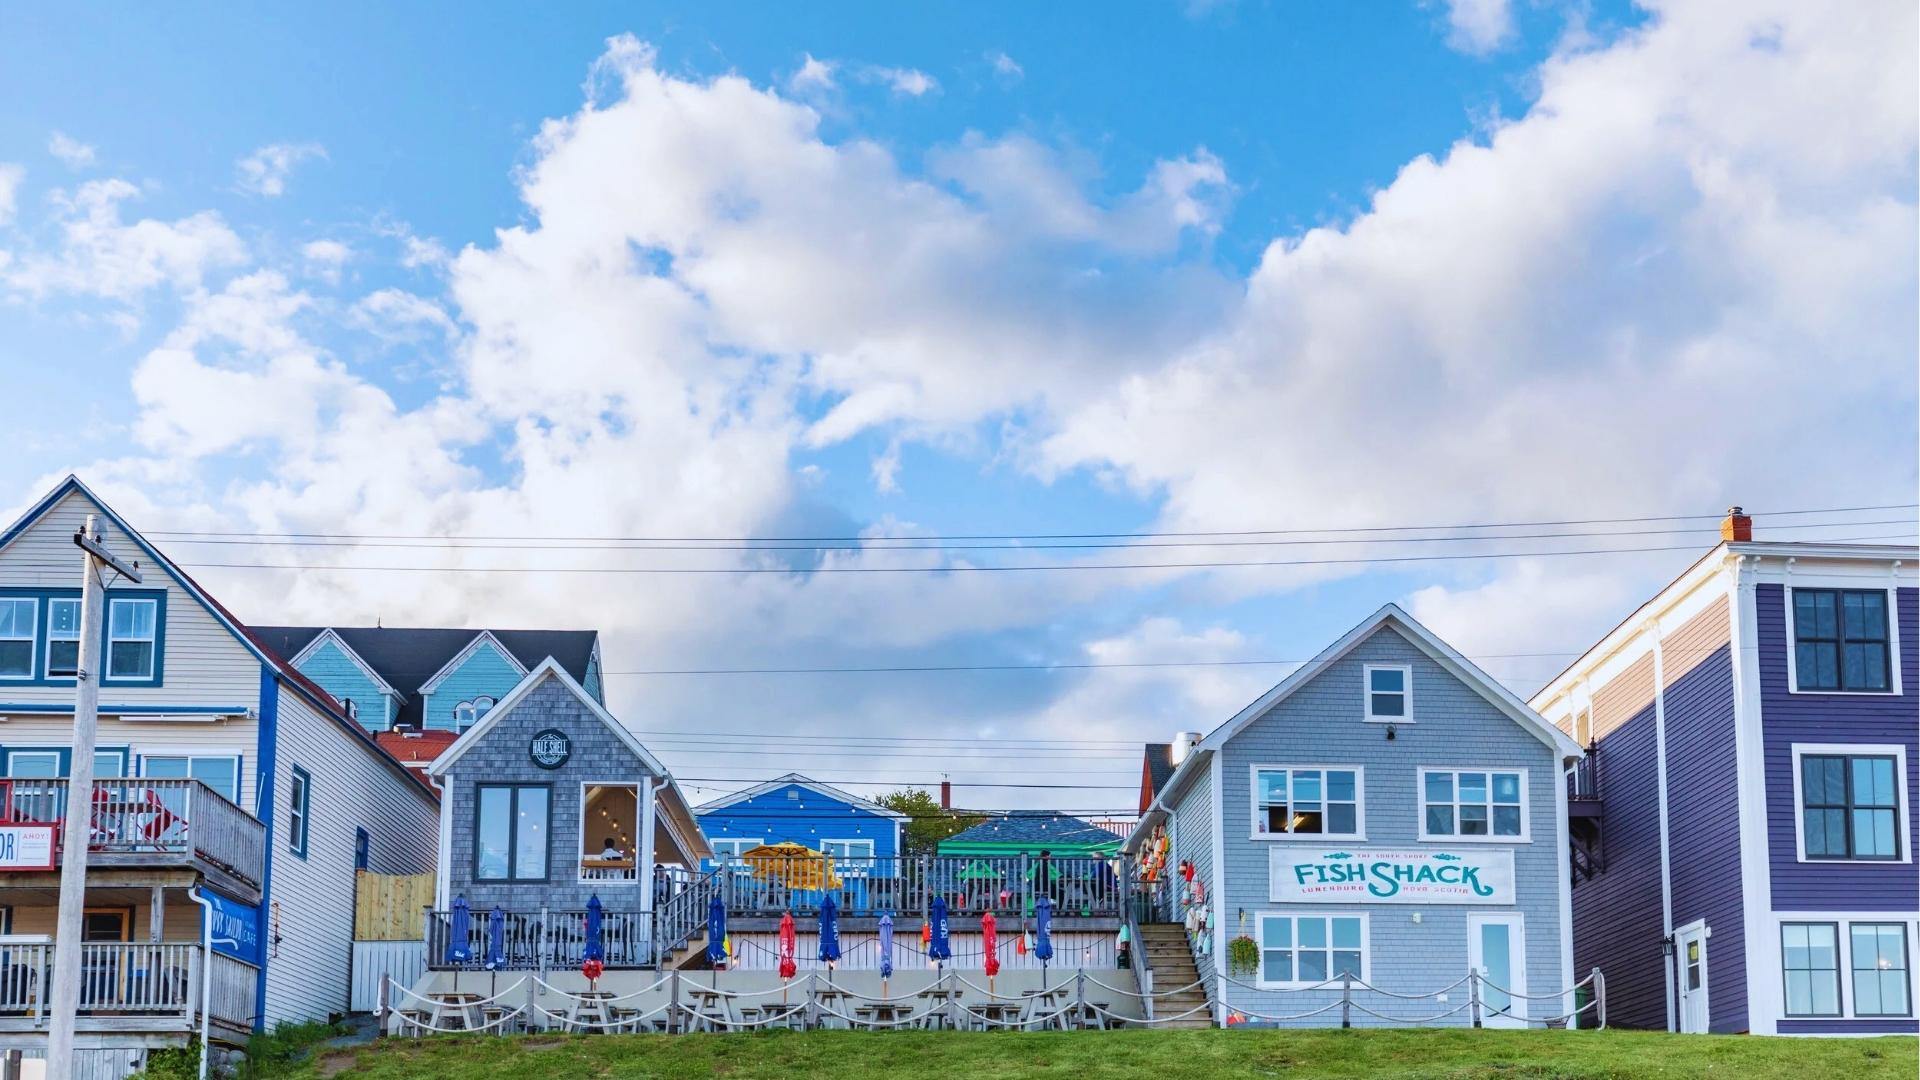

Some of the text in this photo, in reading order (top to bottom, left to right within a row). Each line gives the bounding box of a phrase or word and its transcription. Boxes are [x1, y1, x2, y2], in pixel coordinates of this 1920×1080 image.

[533, 741, 567, 754] HALF SHELL
[1294, 862, 1494, 898] FISH SHACK
[1302, 885, 1364, 893] LUNENBURG
[243, 929, 256, 946] CAFE
